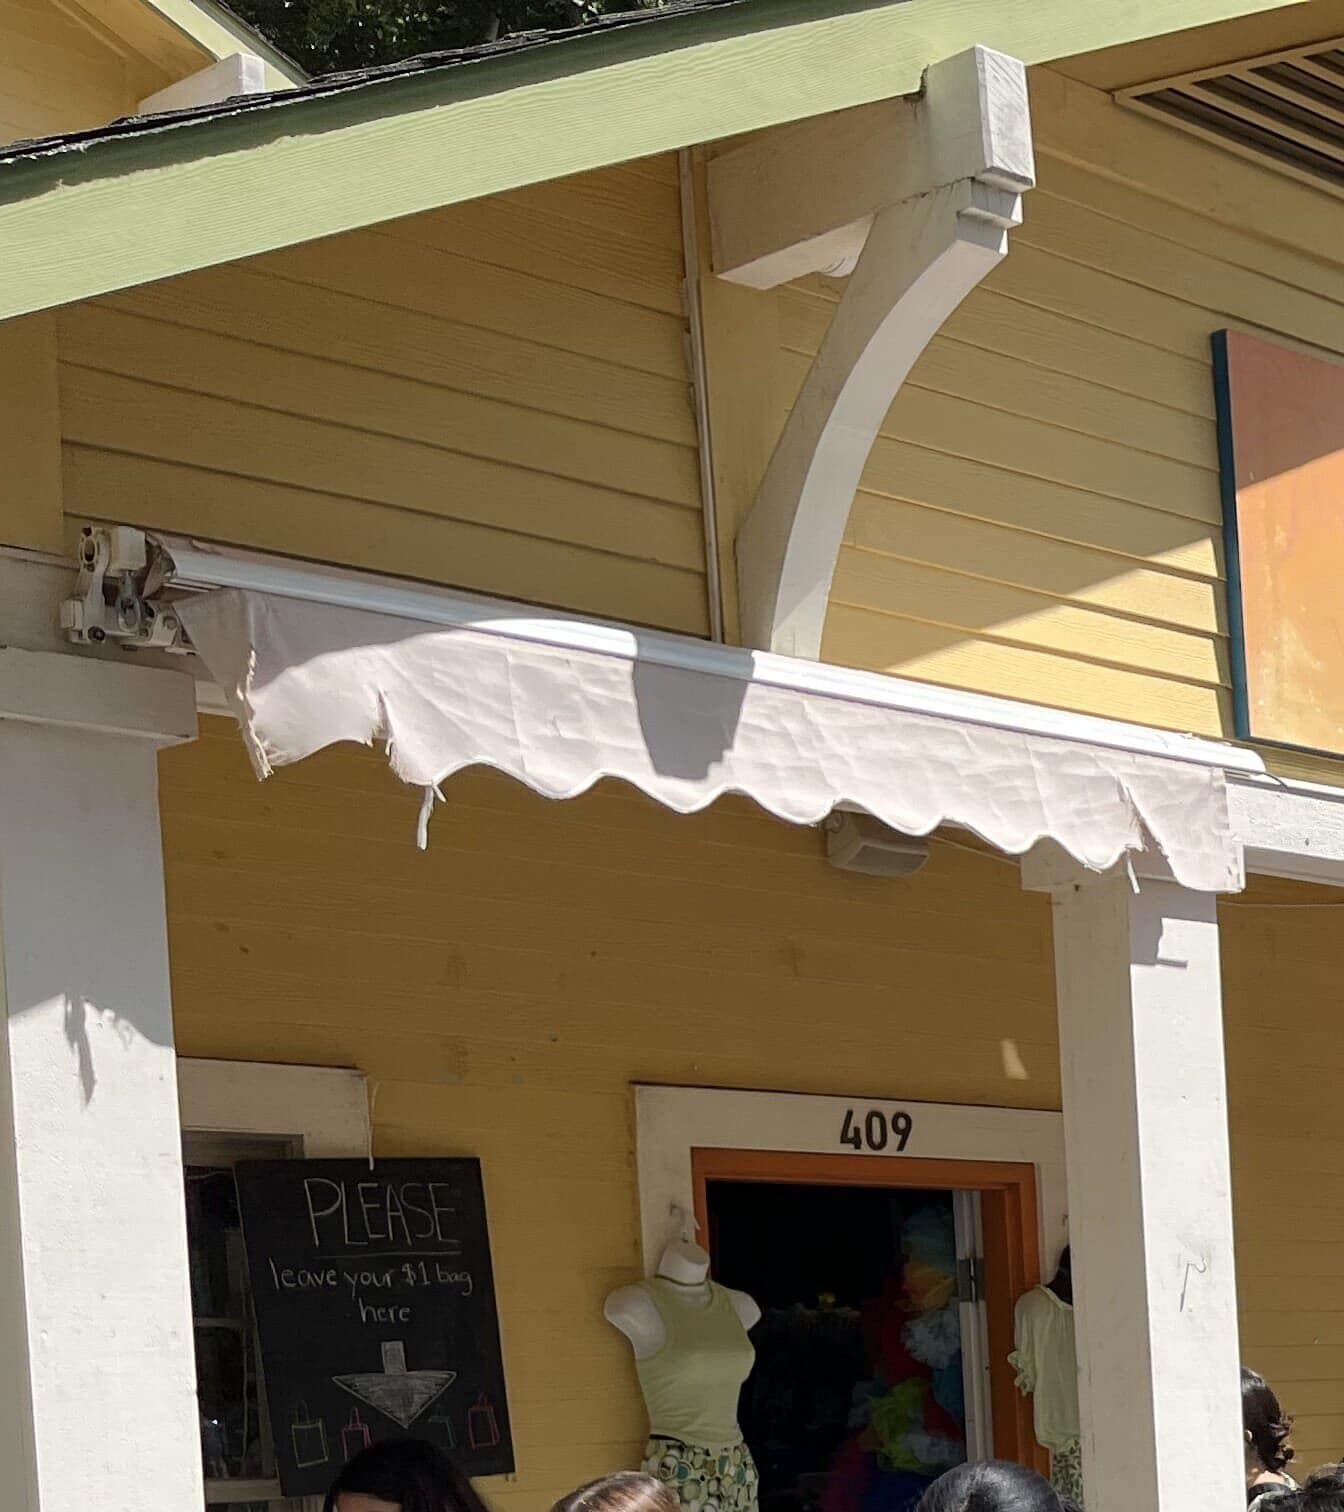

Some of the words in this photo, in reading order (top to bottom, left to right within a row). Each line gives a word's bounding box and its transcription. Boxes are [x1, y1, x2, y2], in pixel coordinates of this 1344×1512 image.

[840, 1109, 912, 1151] 409
[304, 1178, 461, 1247] PLEASE
[269, 1257, 337, 1290] leave
[343, 1268, 394, 1299] your
[402, 1261, 430, 1286] $1
[437, 1263, 473, 1297] bag
[359, 1297, 411, 1324] here
